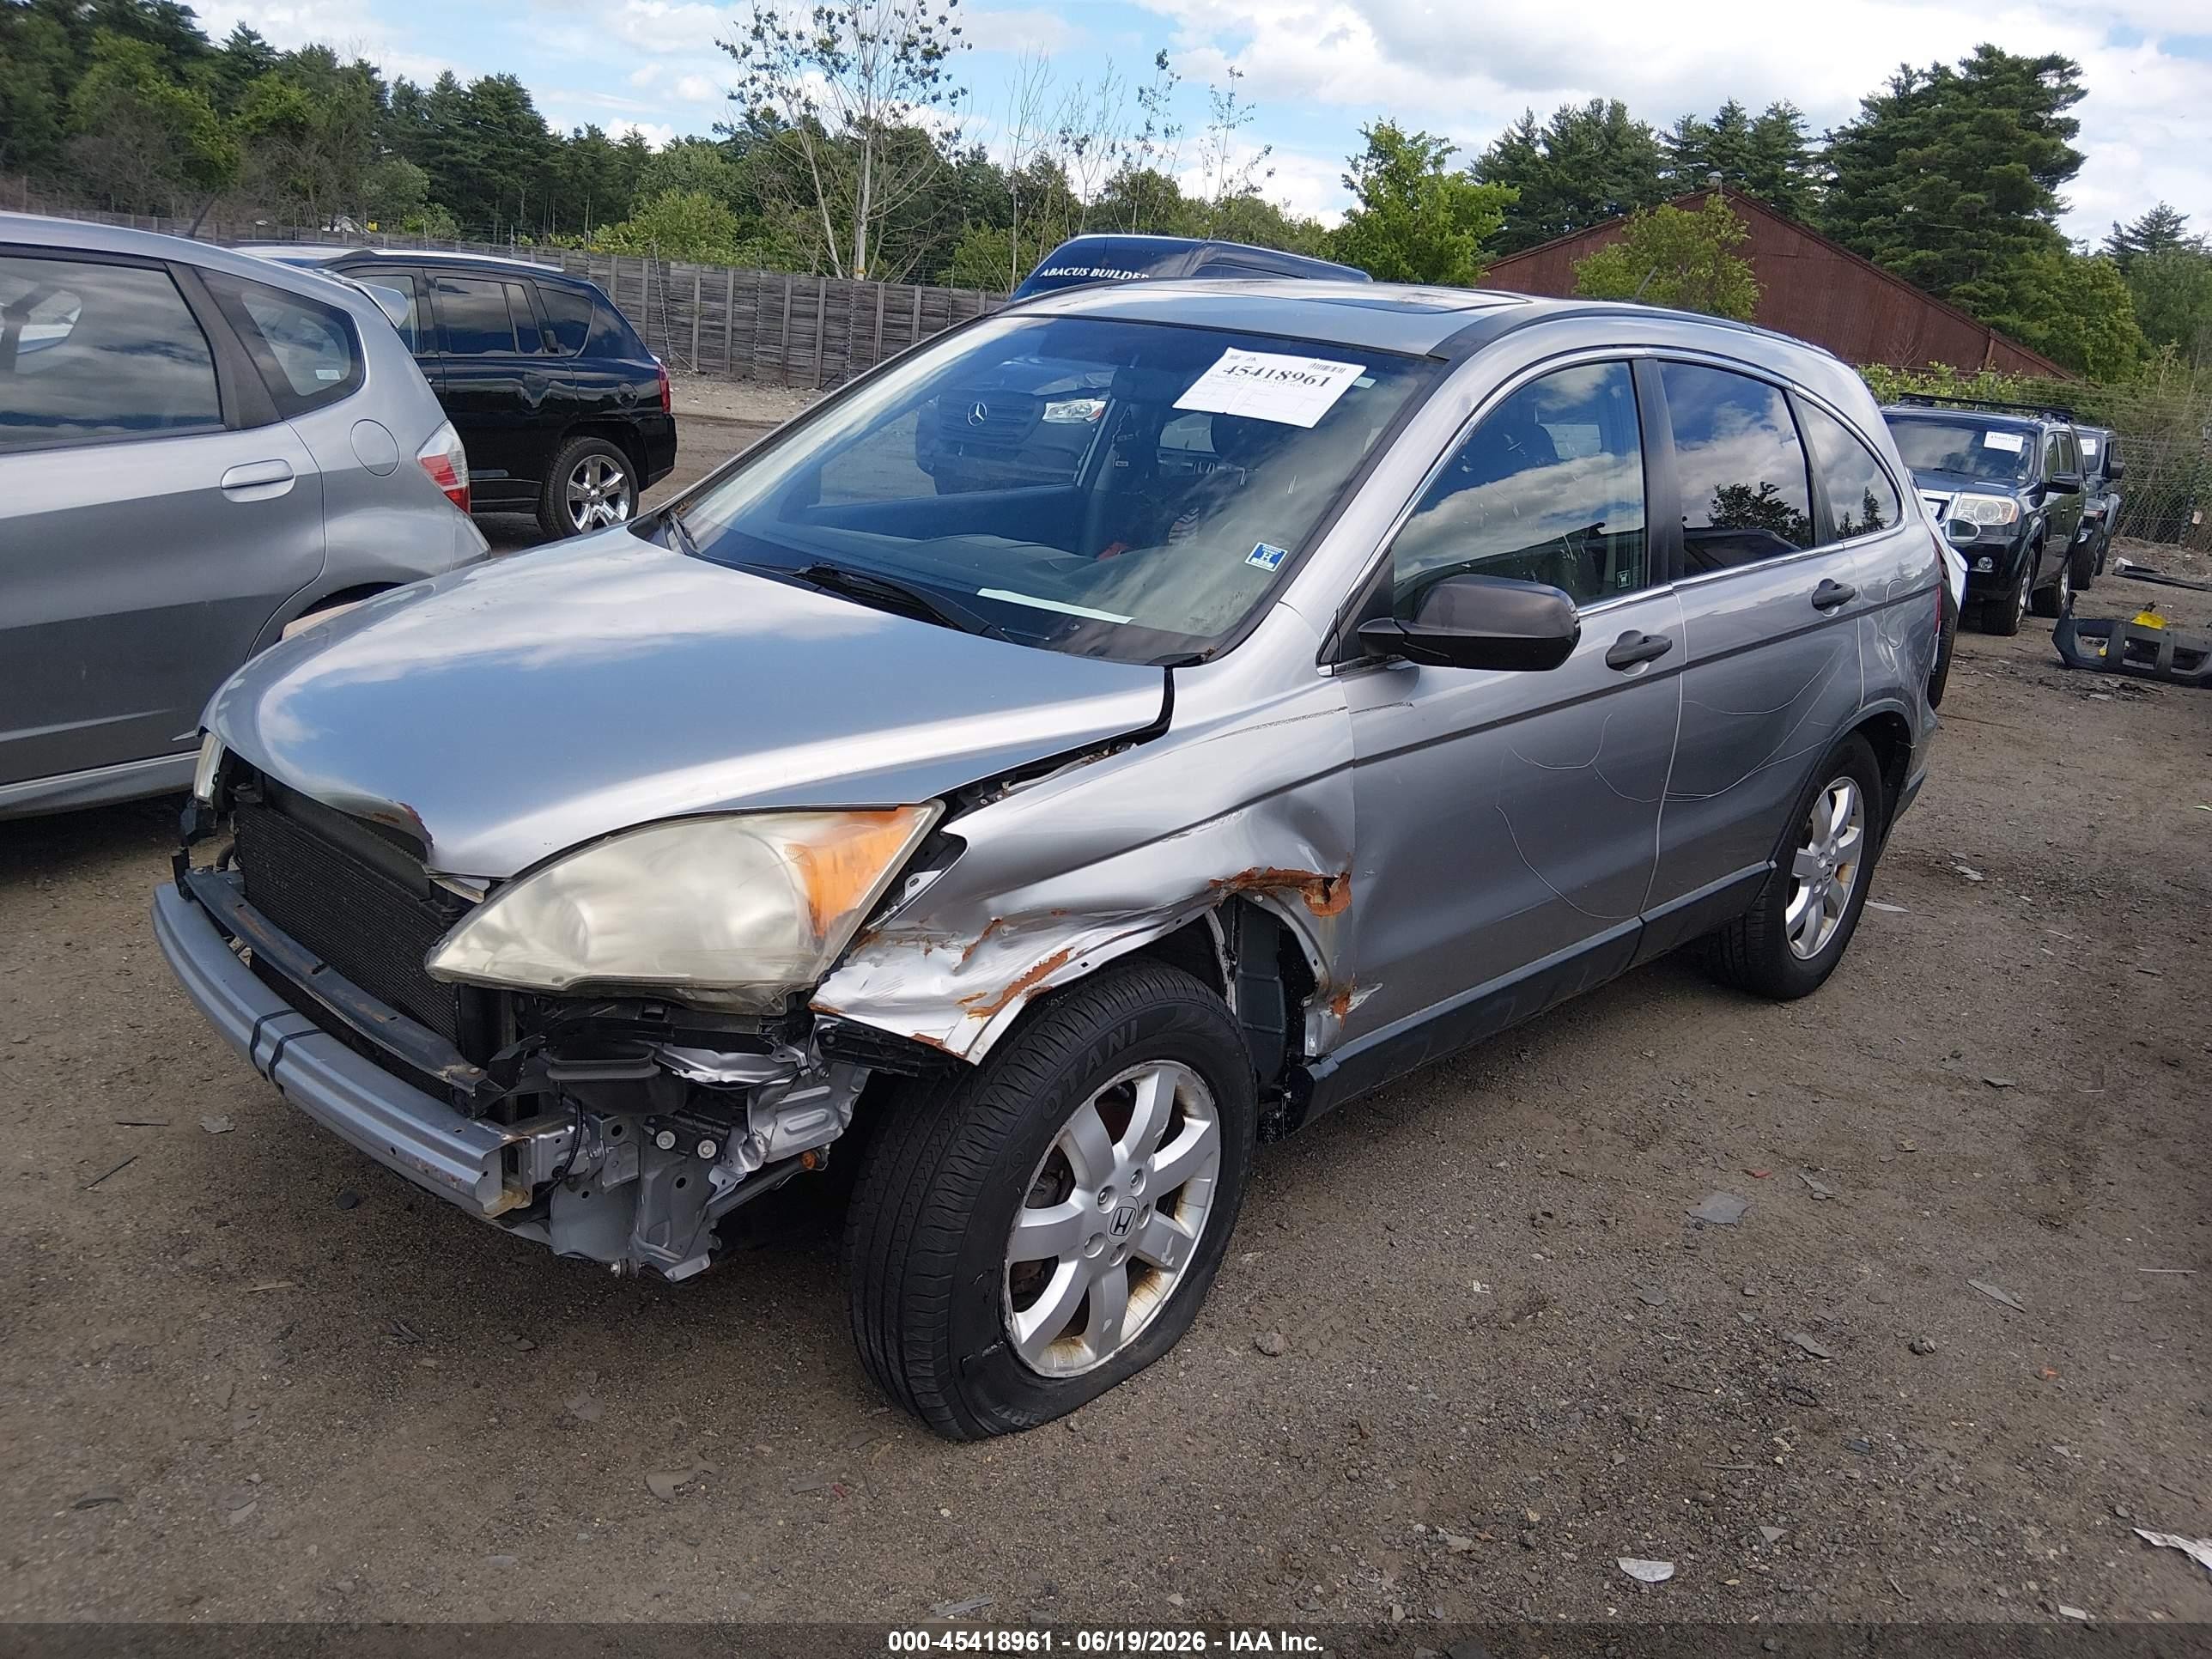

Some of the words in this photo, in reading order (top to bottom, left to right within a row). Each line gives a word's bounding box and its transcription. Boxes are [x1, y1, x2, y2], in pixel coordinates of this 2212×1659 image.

[1040, 267, 1090, 277] ABACUS
[1223, 364, 1332, 387] 45418961
[1042, 1019, 1138, 1120] OTANI
